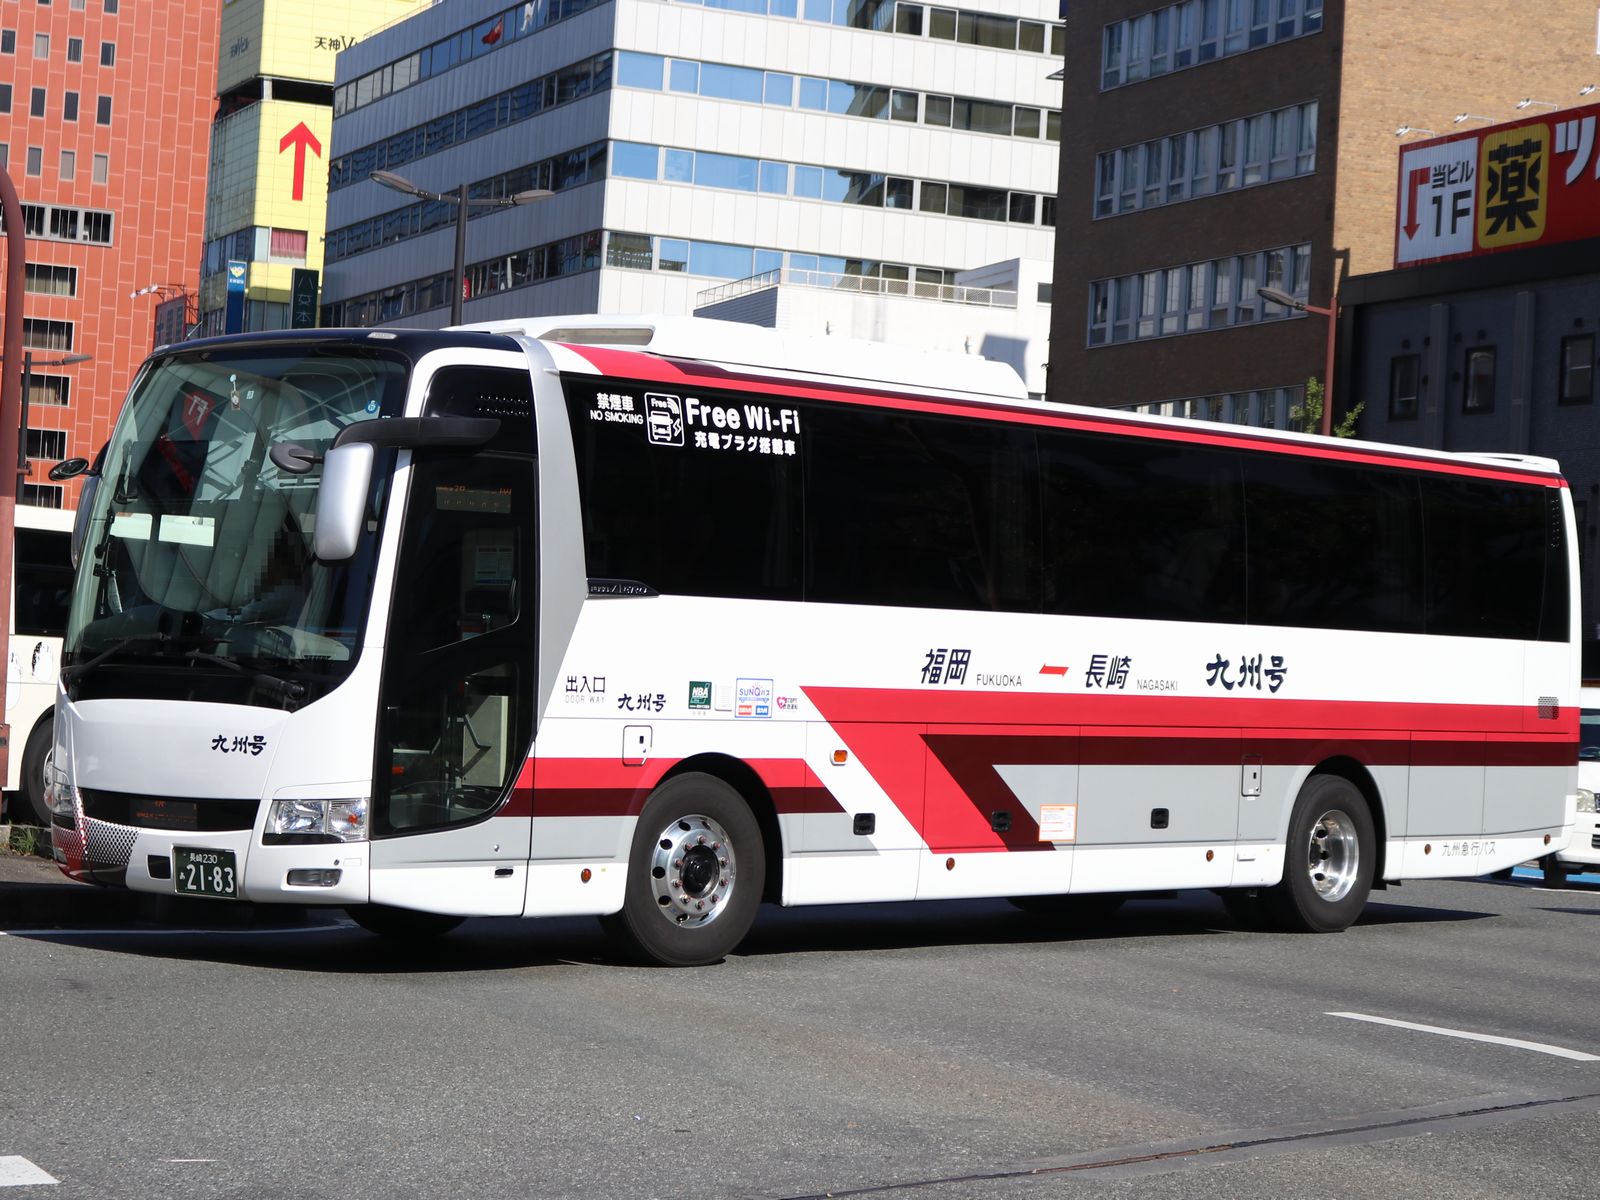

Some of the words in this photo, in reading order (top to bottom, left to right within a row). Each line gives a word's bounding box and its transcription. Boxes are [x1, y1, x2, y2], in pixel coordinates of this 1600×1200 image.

[313, 35, 358, 51] 天神V
[1554, 115, 1600, 187] ツ
[1431, 160, 1475, 190] 当ビル
[1485, 138, 1542, 236] 薬
[1431, 189, 1473, 238] 1F
[596, 392, 635, 412] 禁煙車
[651, 397, 667, 409] Free
[590, 409, 603, 421] NO
[604, 411, 644, 425] SMOKING
[685, 398, 741, 429] Free
[744, 405, 800, 434] Wi-Fi
[694, 430, 796, 456] 充電プラグ搭載車
[921, 648, 972, 685] 福岡
[976, 673, 1022, 687] FUKUOKA
[1085, 654, 1132, 690] 長崎
[1136, 679, 1178, 691] NAGASAKI
[1205, 653, 1288, 693] 九州号
[565, 676, 606, 693] 出入口
[564, 694, 585, 704] DOOR
[589, 696, 606, 704] WAY
[617, 693, 667, 712] 九州号
[211, 735, 267, 756] 九州号
[1442, 841, 1496, 857] 九州急行バス
[190, 854, 202, 864] 長崎
[203, 854, 218, 865] 230
[187, 864, 233, 893] 21-83
